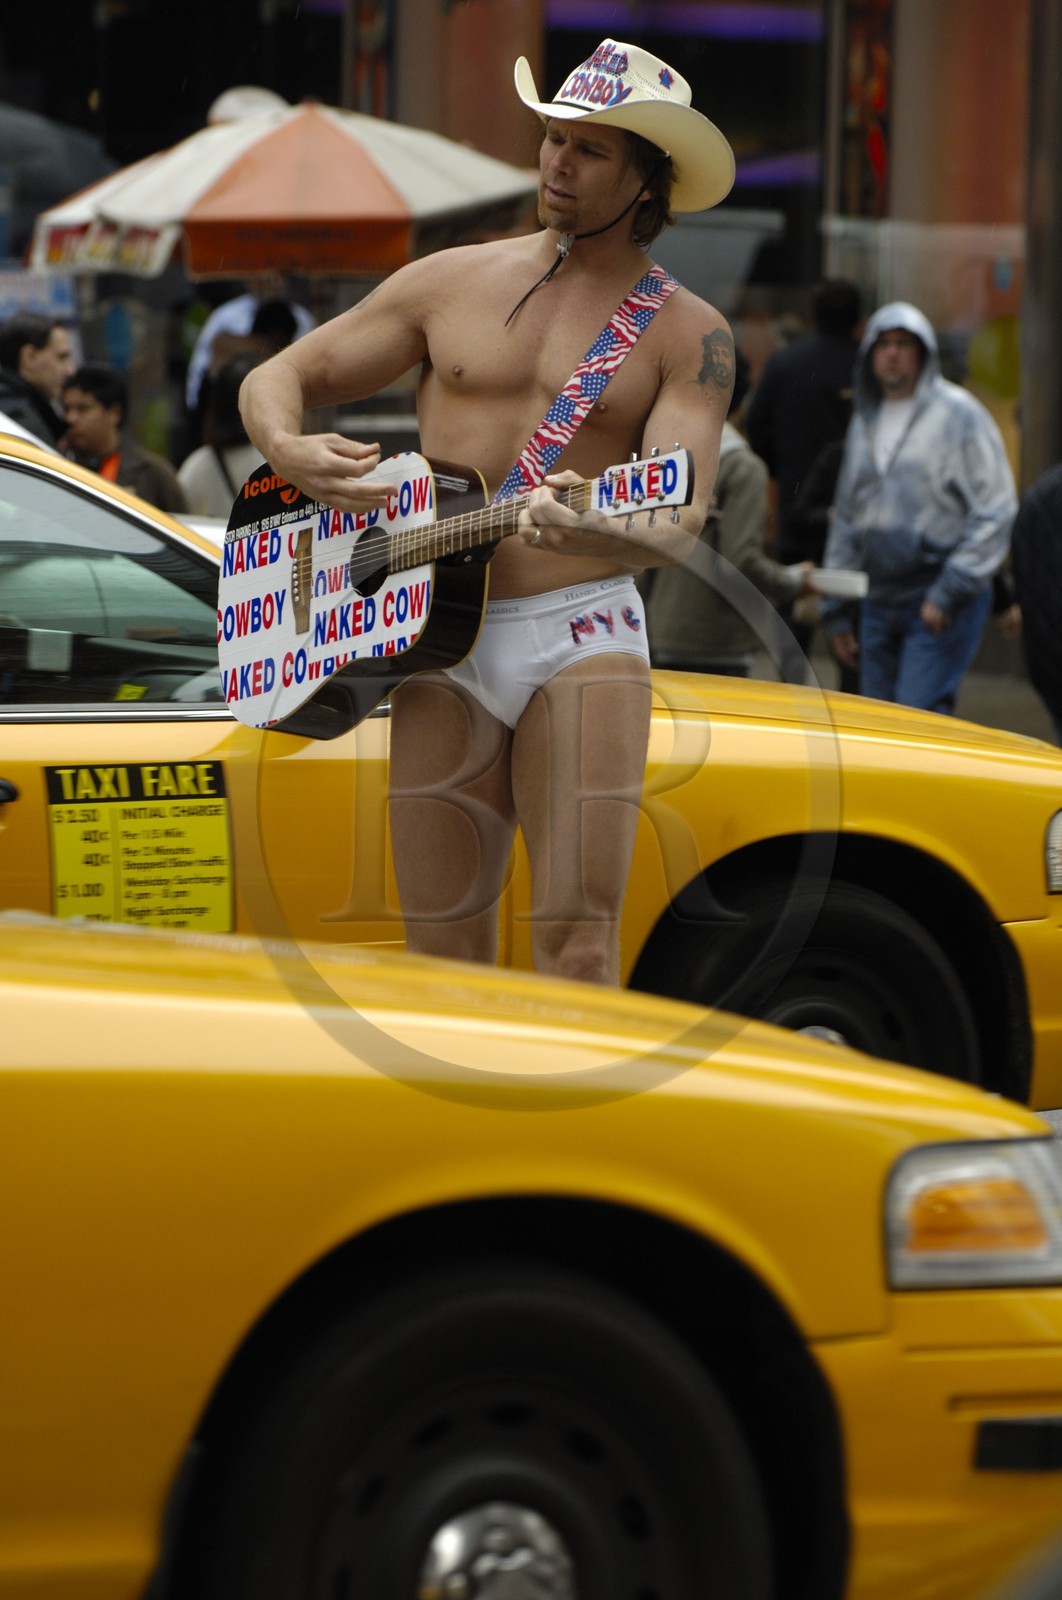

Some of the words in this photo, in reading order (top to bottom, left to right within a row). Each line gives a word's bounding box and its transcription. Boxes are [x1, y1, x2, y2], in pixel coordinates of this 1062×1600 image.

[560, 72, 633, 107] COWBOY
[386, 475, 434, 522] COW
[598, 459, 678, 509] NAKED
[282, 511, 299, 525] Entrance
[222, 528, 282, 579] NAKED
[217, 588, 287, 645] COWBOY
[313, 597, 377, 648] NAKED
[568, 605, 641, 646] NYC
[220, 657, 276, 704] NAKED
[55, 767, 131, 800] TAXI
[140, 764, 217, 797] FARE
[171, 804, 225, 818] CHARGE
